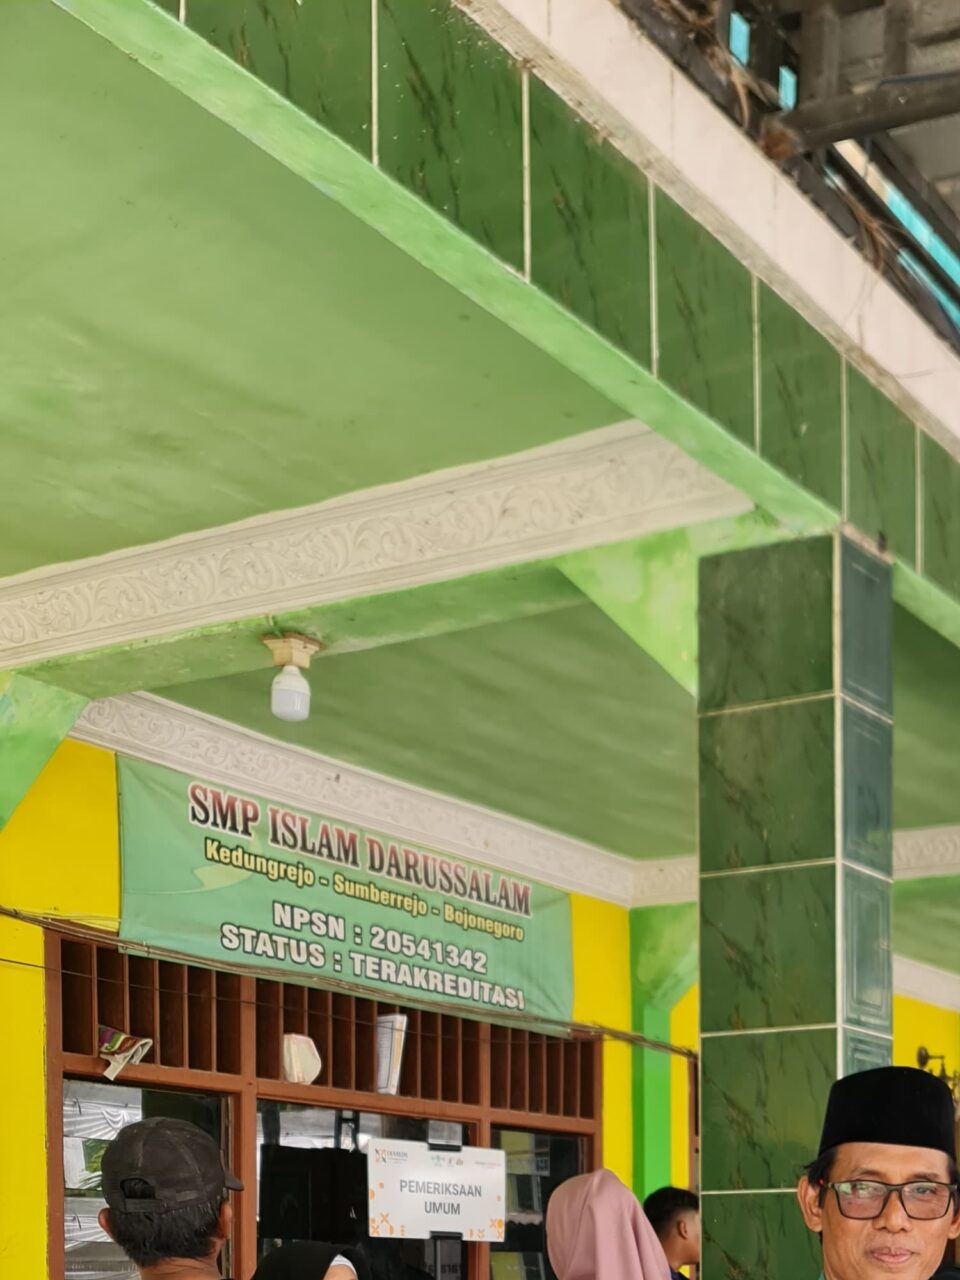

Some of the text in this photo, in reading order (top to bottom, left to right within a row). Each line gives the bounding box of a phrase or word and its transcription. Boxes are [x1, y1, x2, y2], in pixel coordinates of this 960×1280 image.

[189, 783, 531, 917] SMP ISLAM DARUSSALAM
[206, 837, 314, 887] Kedungrejo
[333, 872, 428, 916] Sumberrejo
[443, 903, 525, 941] Bojonegoro
[221, 923, 325, 968] STATUS
[350, 952, 526, 1010] TERAKREDITASI
[273, 901, 345, 941] NPSN
[370, 926, 488, 974] 20541342
[400, 1180, 482, 1197] PEMERIKSAAN
[424, 1202, 461, 1215] UMUM
